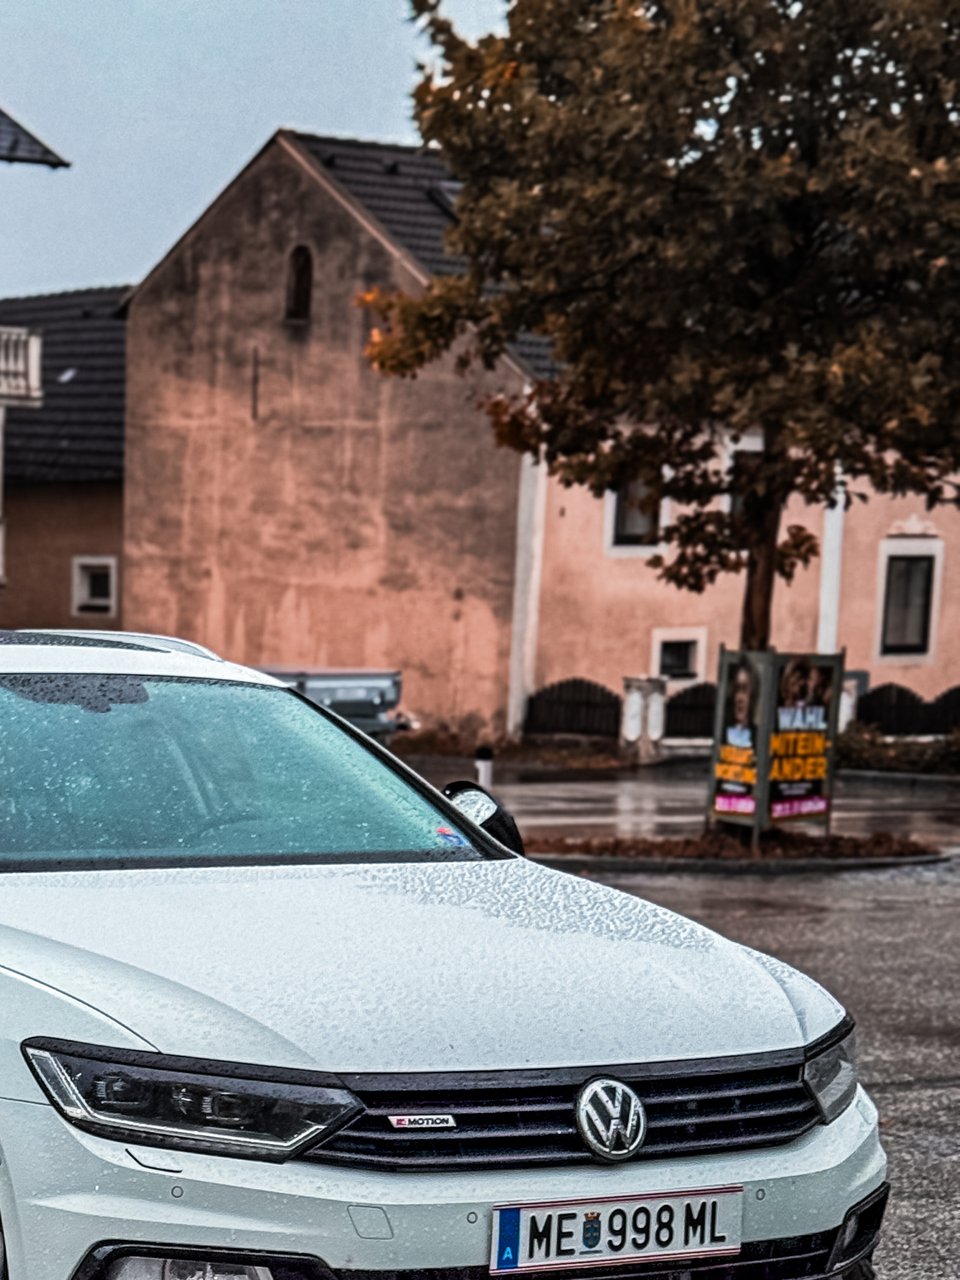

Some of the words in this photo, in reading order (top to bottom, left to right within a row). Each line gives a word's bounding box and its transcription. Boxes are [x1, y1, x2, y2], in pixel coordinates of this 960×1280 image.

[769, 756, 828, 781] ANDER
[581, 1080, 644, 1156] VW
[529, 1212, 577, 1259] ME
[607, 1204, 675, 1252] 998
[683, 1200, 726, 1246] ML
[502, 1246, 513, 1260] A
